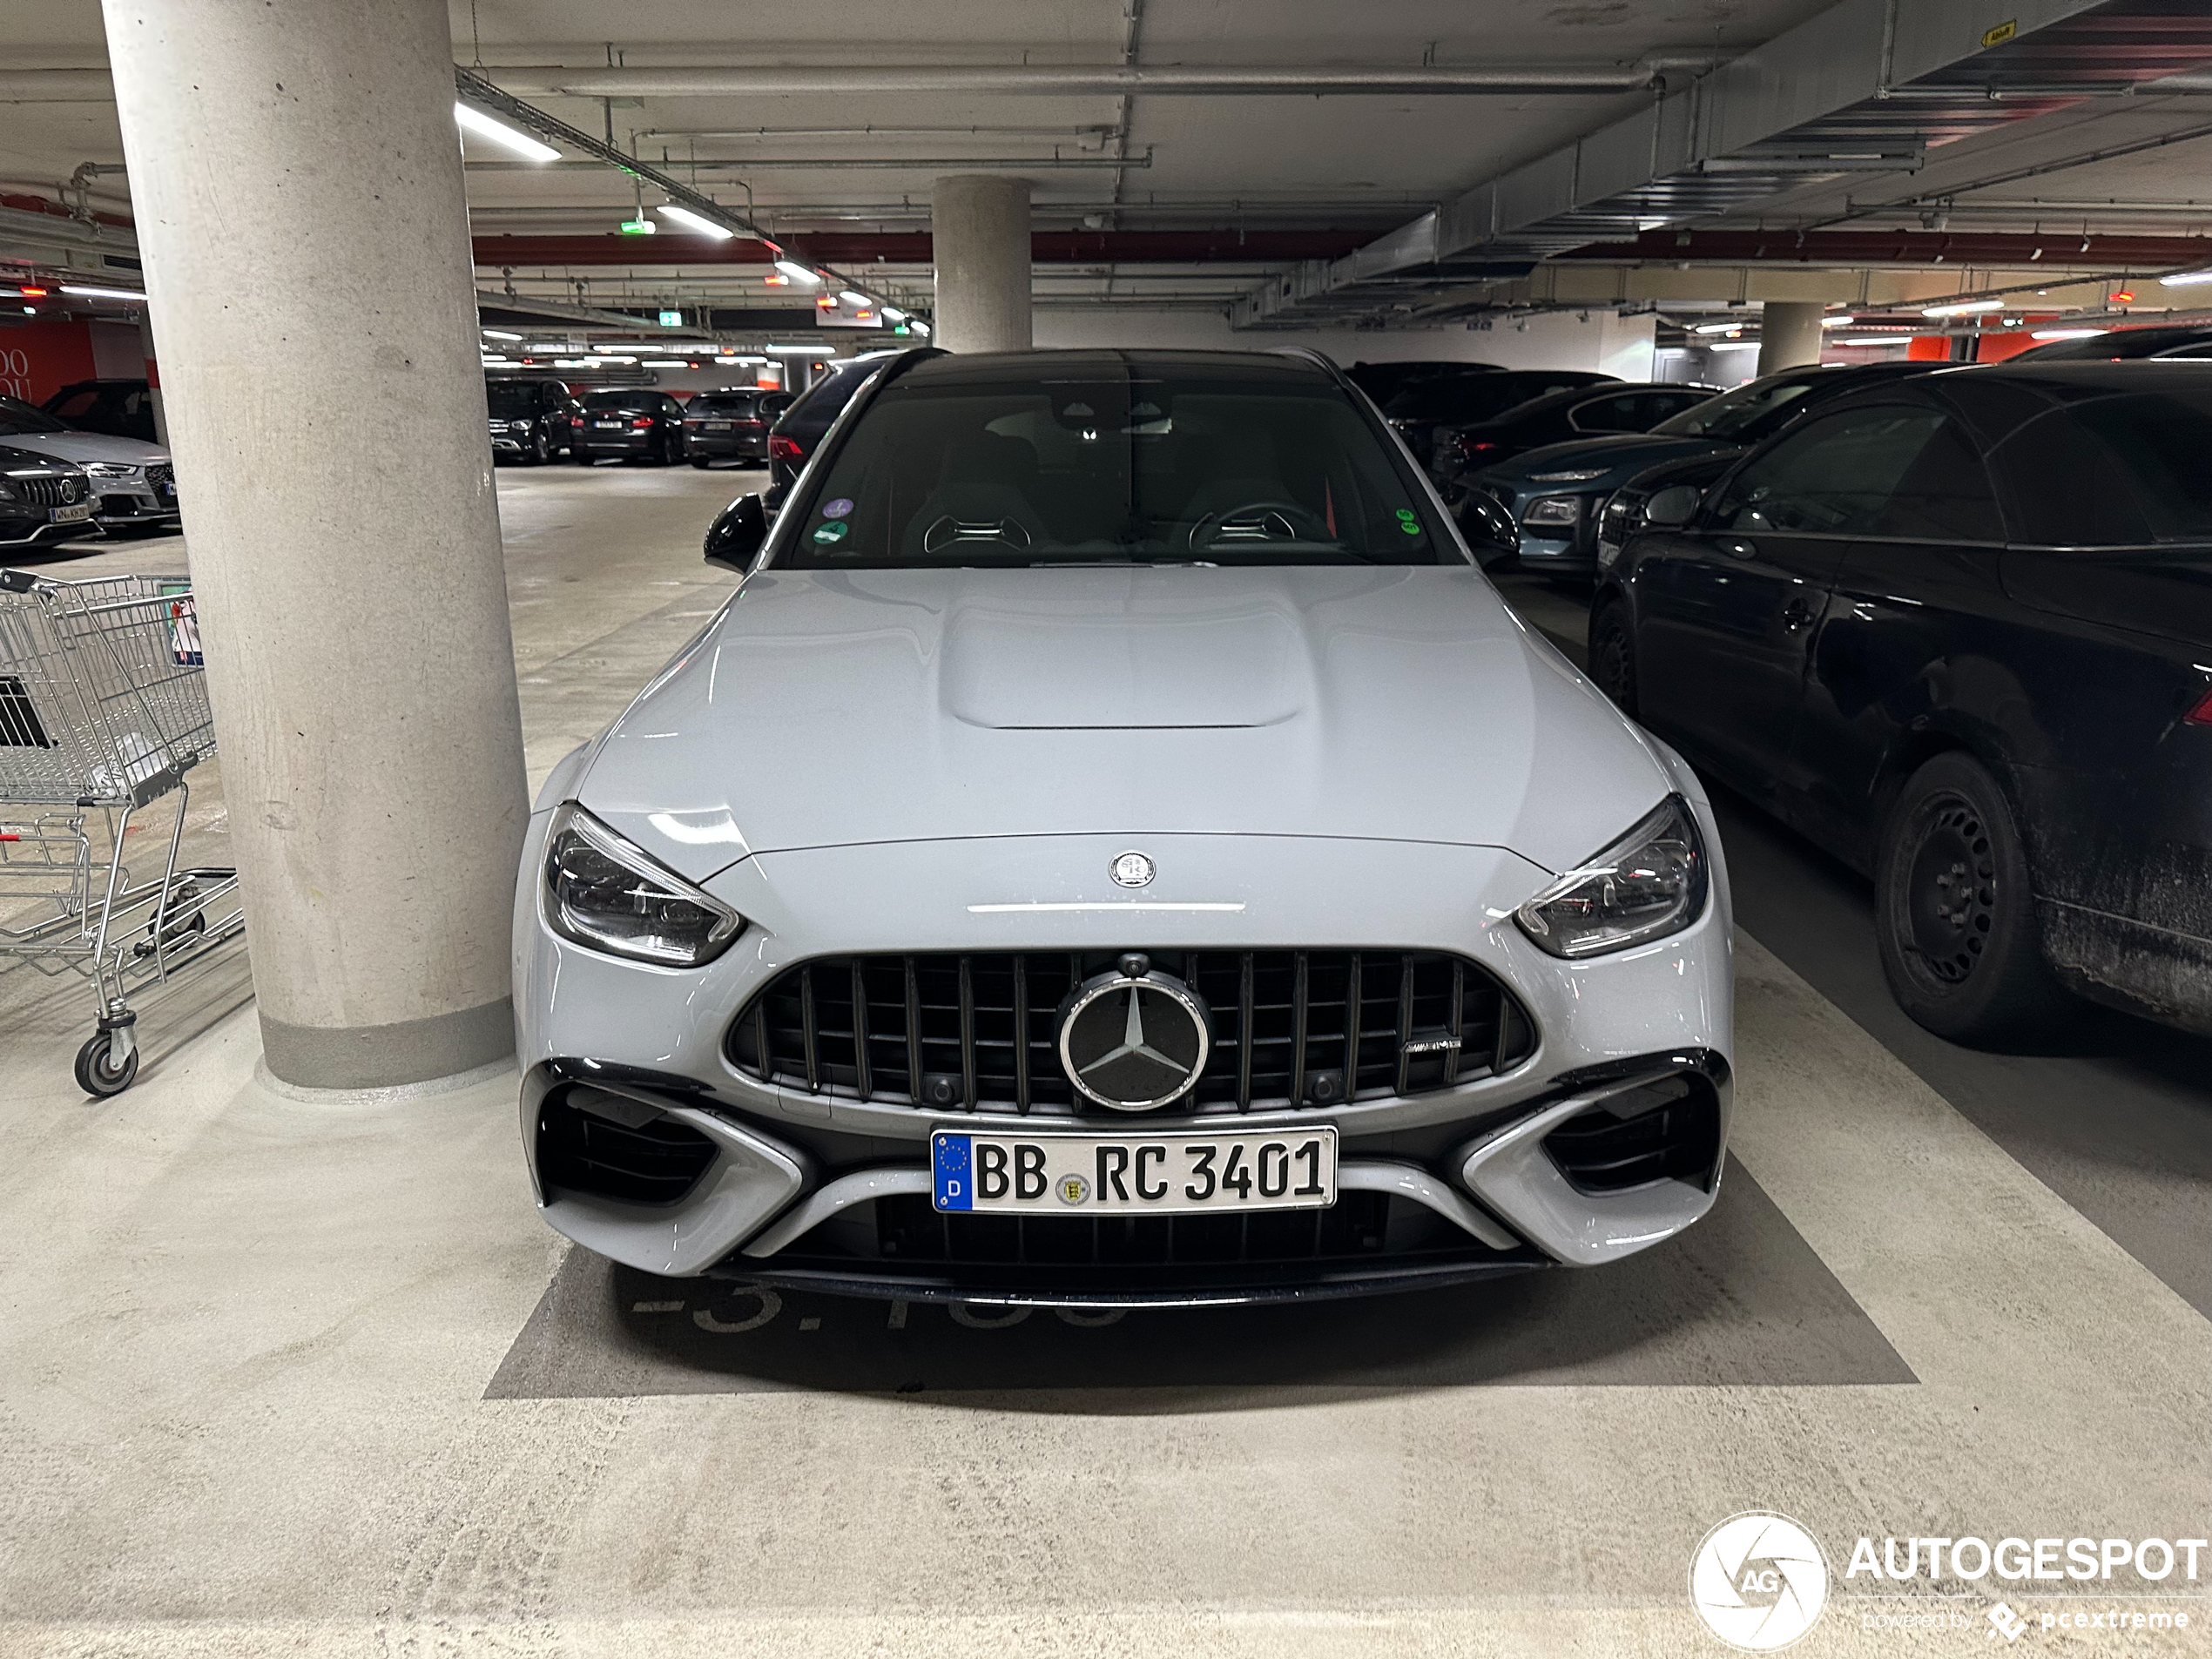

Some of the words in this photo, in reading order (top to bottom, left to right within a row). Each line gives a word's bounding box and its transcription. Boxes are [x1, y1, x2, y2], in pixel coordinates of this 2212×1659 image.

[948, 1180, 961, 1197] D
[976, 1143, 1048, 1199] BB
[1096, 1145, 1168, 1201] RC
[1184, 1140, 1325, 1201] 3401
